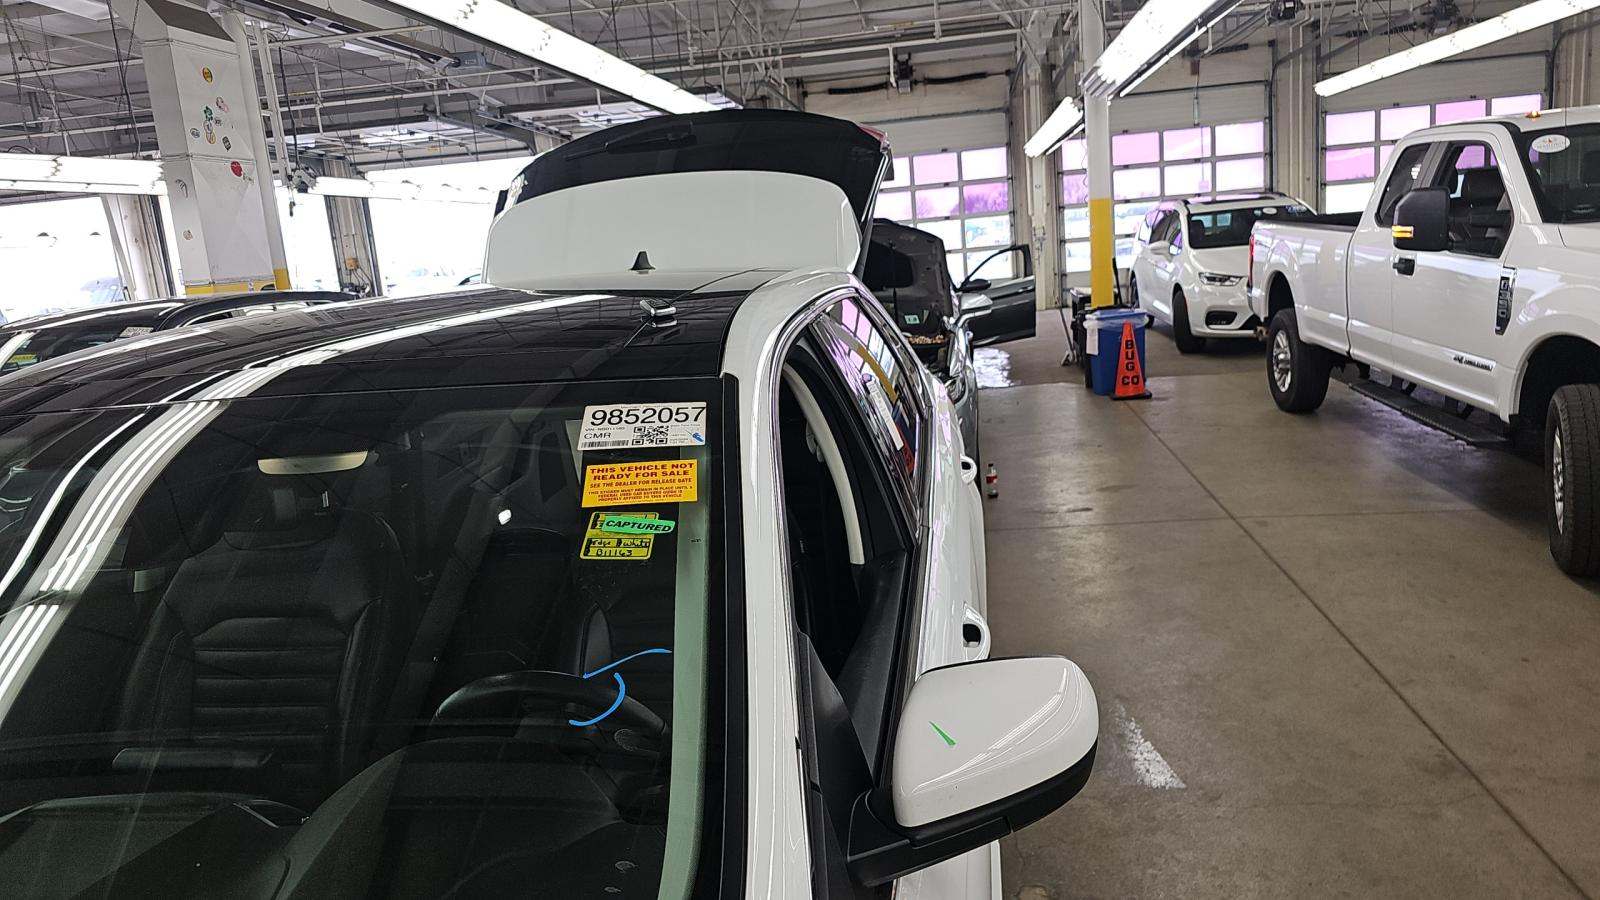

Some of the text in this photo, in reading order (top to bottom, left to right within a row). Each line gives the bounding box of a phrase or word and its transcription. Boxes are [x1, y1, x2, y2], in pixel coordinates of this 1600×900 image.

[590, 407, 706, 426] 9852057
[620, 464, 668, 472] VEHICLE
[593, 473, 631, 481] READY
[661, 469, 690, 477] SALE
[605, 520, 672, 532] CAPTURED
